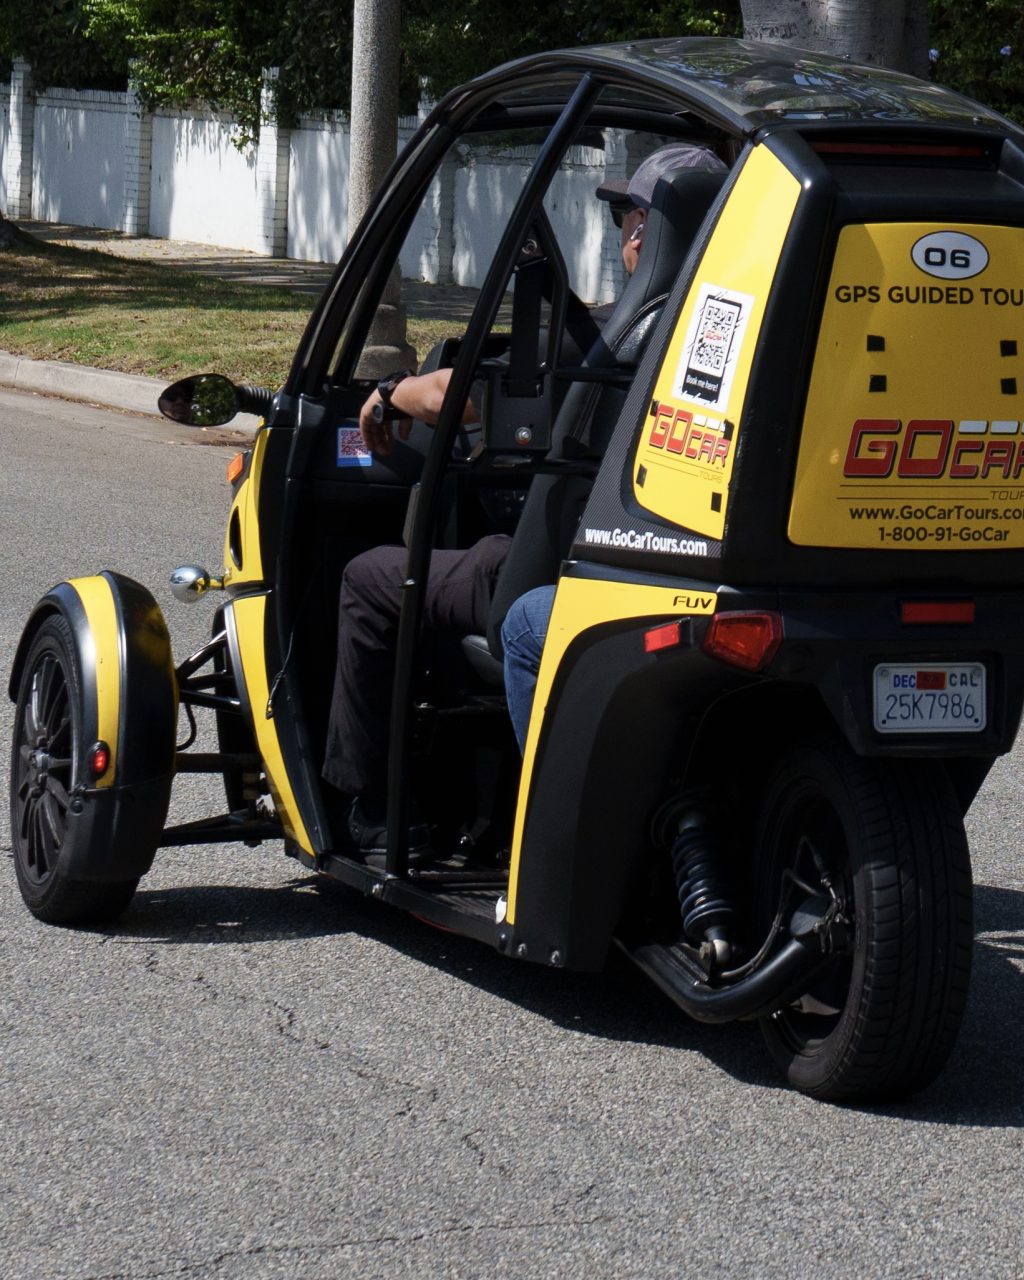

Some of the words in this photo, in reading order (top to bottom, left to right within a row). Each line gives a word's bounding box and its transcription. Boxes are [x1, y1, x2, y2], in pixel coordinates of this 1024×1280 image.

[924, 247, 971, 268] 06
[835, 285, 880, 304] GPS
[888, 286, 974, 306] GUIDED
[585, 528, 708, 556] www.GoCarTours.com
[878, 527, 1010, 542] 1-800-91-GoCar
[672, 595, 713, 609] FUV
[893, 674, 916, 688] DEC
[949, 673, 978, 687] CAL
[886, 693, 975, 720] 25K7986
